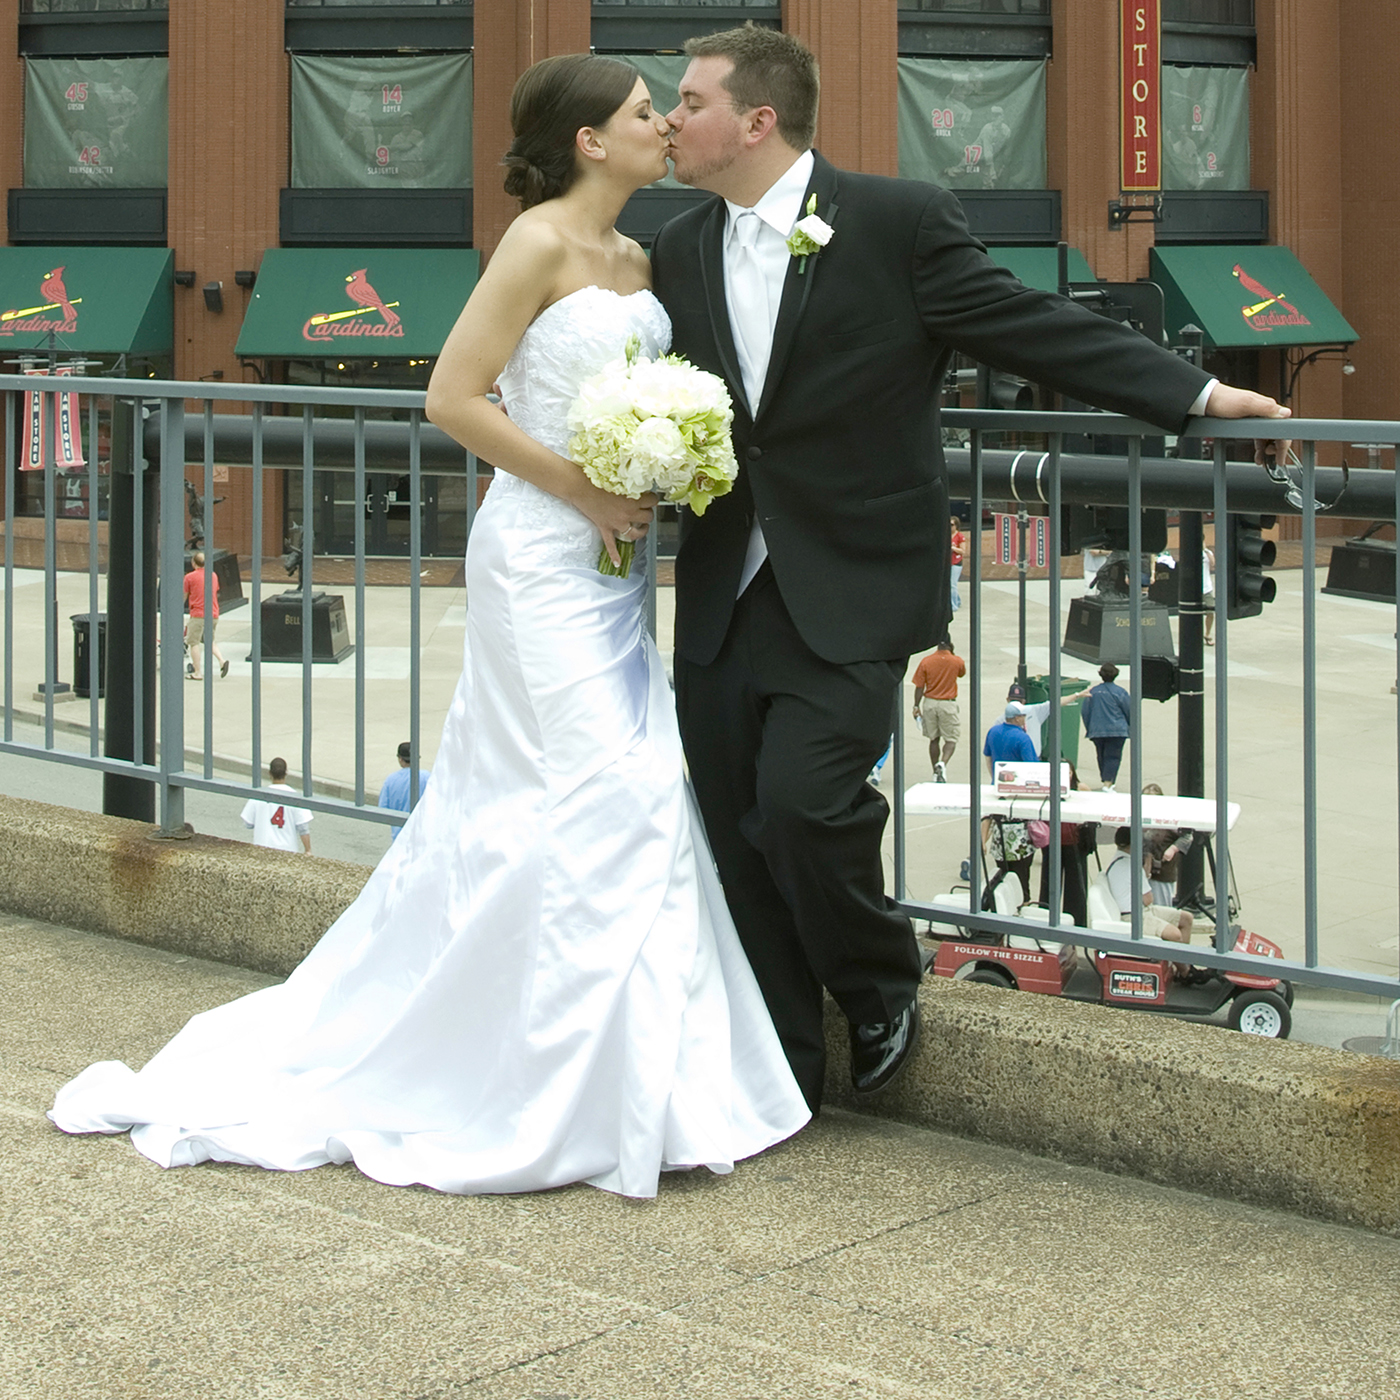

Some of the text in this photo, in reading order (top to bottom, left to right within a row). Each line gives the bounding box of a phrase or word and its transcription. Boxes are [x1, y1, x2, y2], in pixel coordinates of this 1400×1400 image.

[65, 82, 88, 102] 45
[382, 84, 402, 105] 14
[1132, 9, 1149, 174] STORE
[931, 108, 954, 129] 20
[1193, 104, 1202, 124] 6
[78, 146, 101, 166] 42
[375, 146, 389, 166] 9
[964, 144, 982, 165] 17
[1207, 152, 1217, 170] 2
[302, 313, 405, 341] Cardinals
[270, 806, 285, 829] 4
[954, 945, 1044, 963] FOLLOW THE SIZZLE
[1113, 974, 1142, 982] RUTH'S
[1118, 981, 1153, 992] CHRIS
